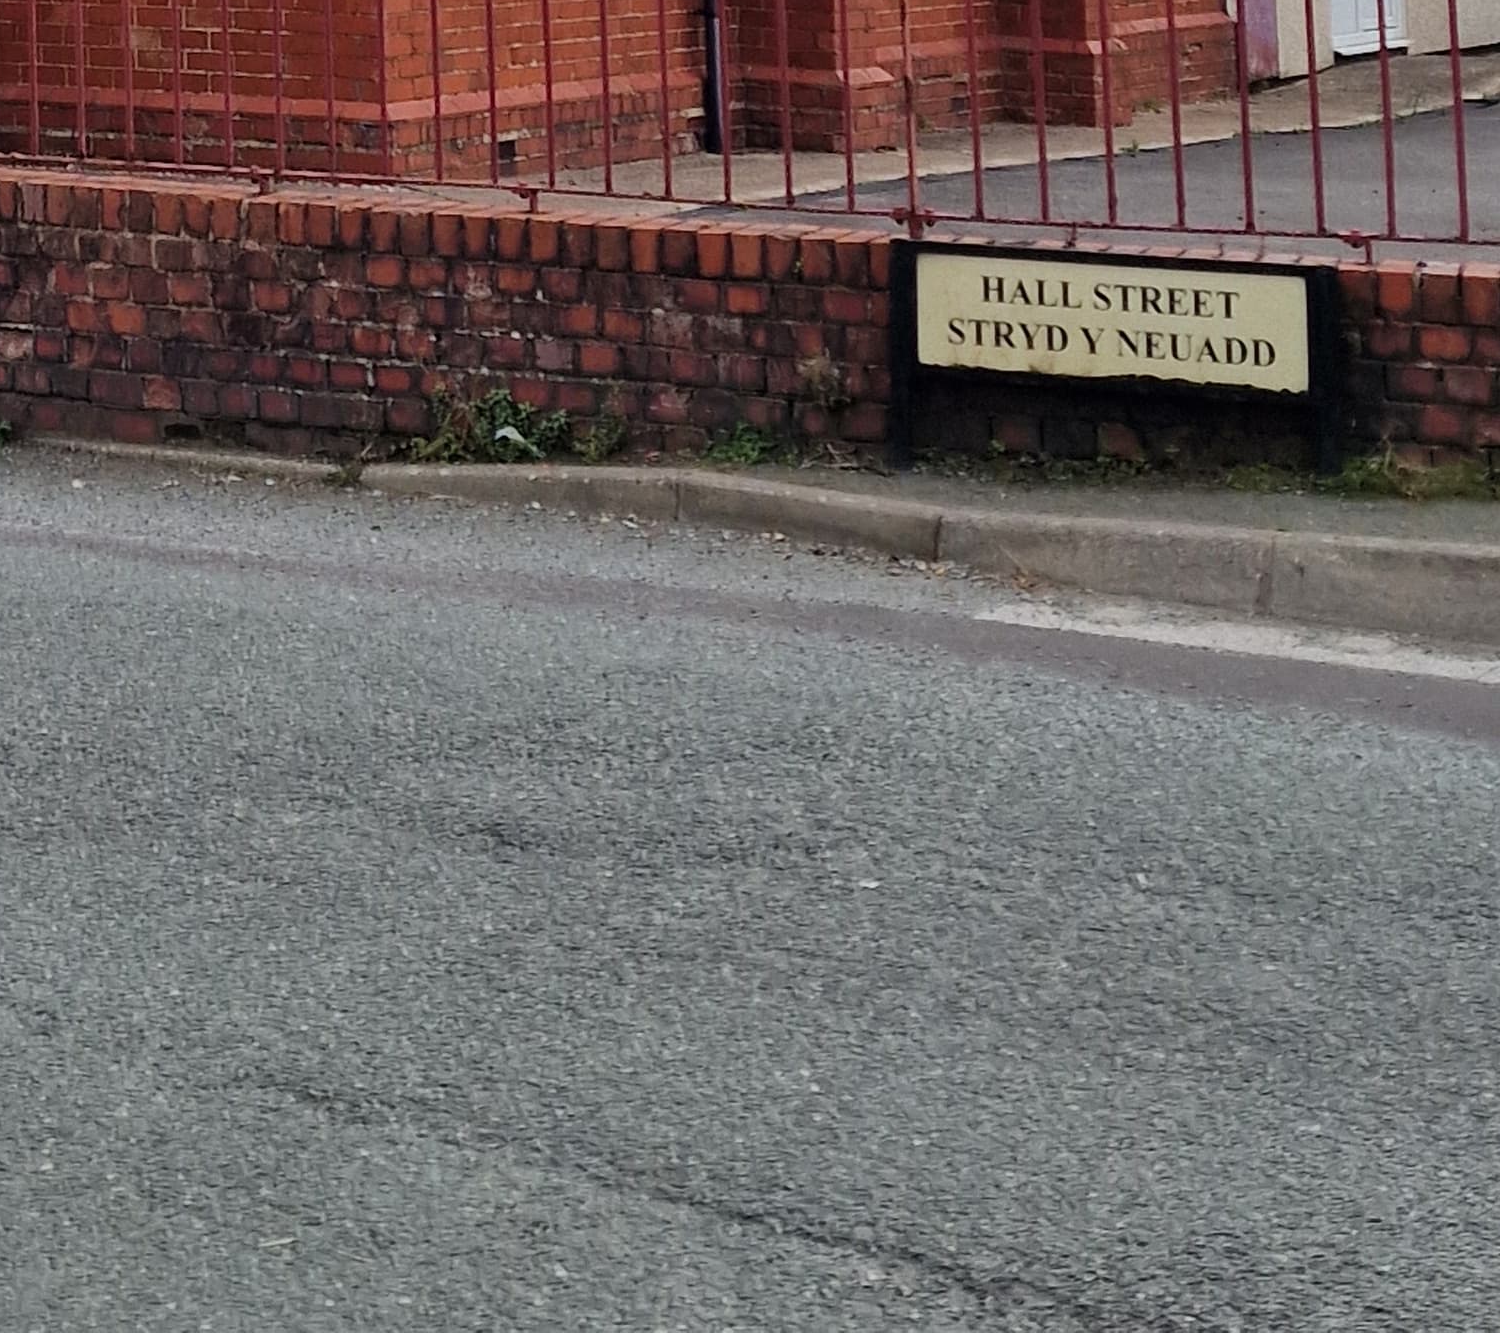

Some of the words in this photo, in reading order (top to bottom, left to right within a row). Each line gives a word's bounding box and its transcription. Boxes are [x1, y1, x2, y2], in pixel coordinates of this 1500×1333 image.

[981, 275, 1082, 309] HALL
[1093, 283, 1240, 320] STREET
[947, 317, 1069, 353] STRYD
[1079, 327, 1104, 355] Y
[1116, 329, 1276, 368] NEUADD
